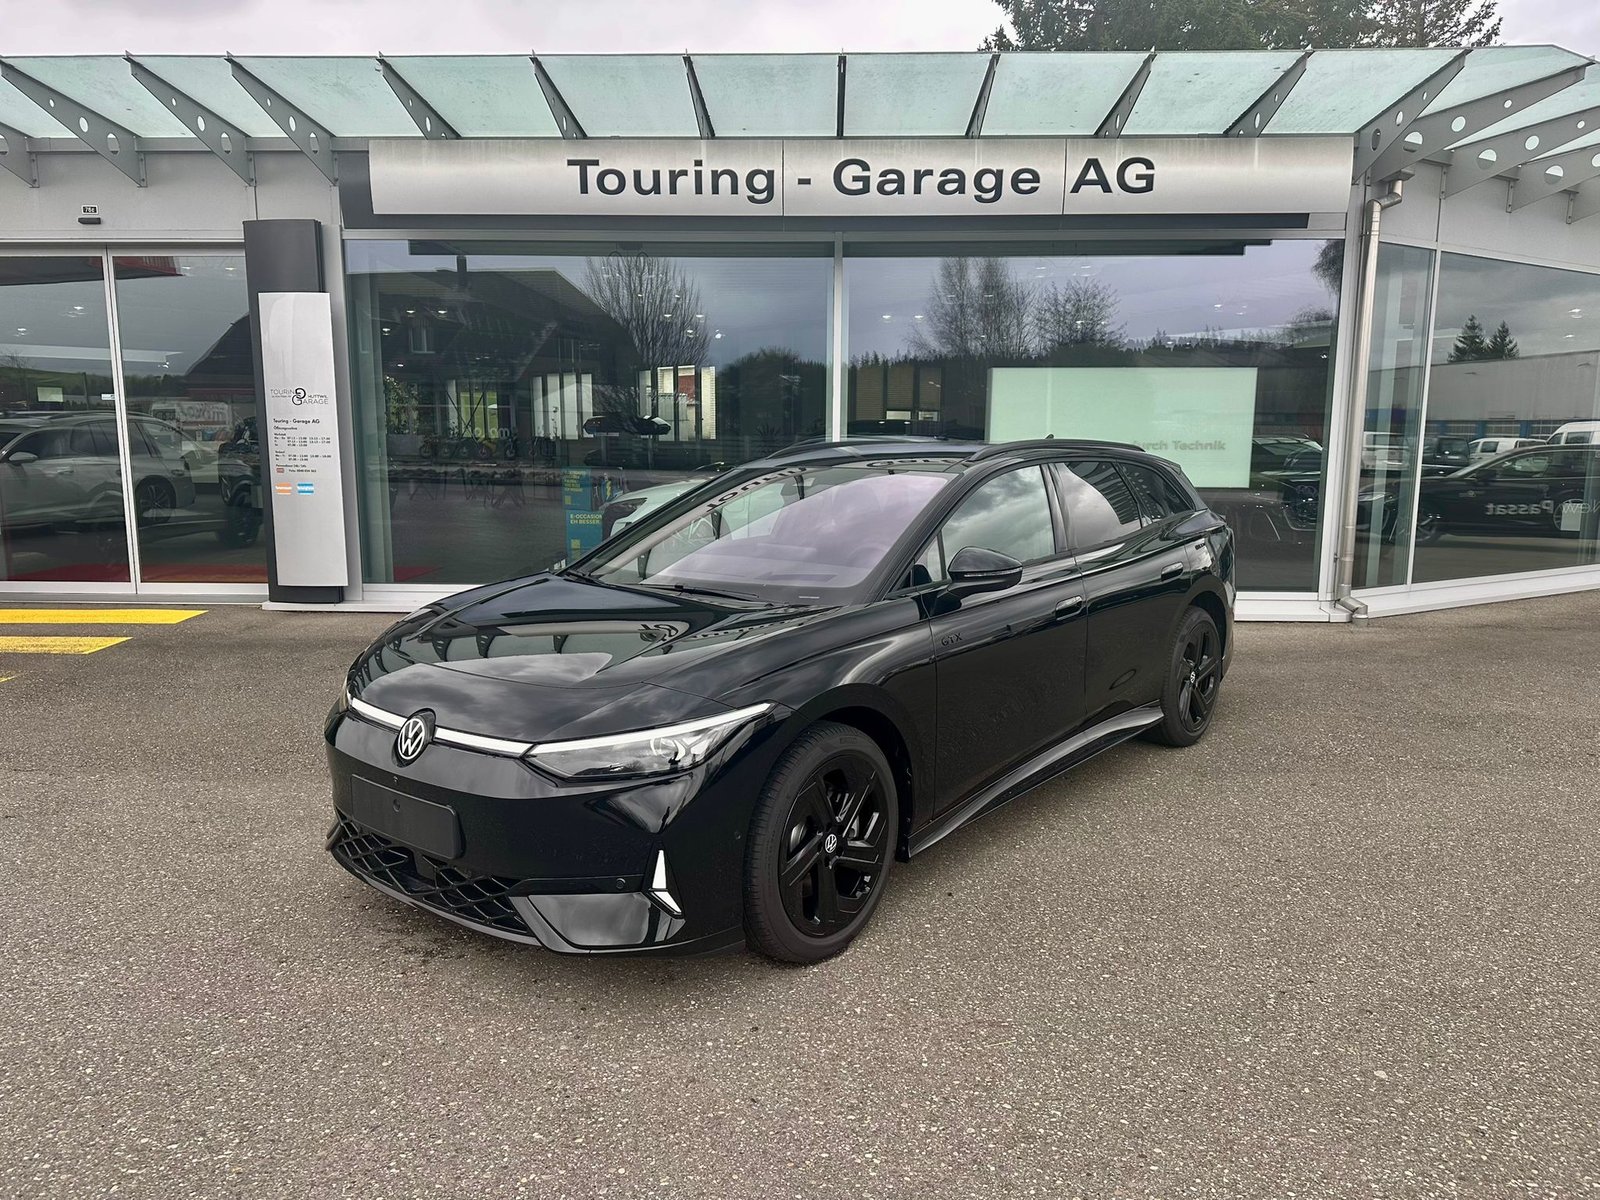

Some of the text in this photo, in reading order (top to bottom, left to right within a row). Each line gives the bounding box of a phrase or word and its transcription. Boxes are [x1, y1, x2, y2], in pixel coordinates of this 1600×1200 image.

[567, 156, 1156, 204] Touring - Garage AG
[1173, 440, 1225, 451] Technik
[941, 632, 962, 646] GTX
